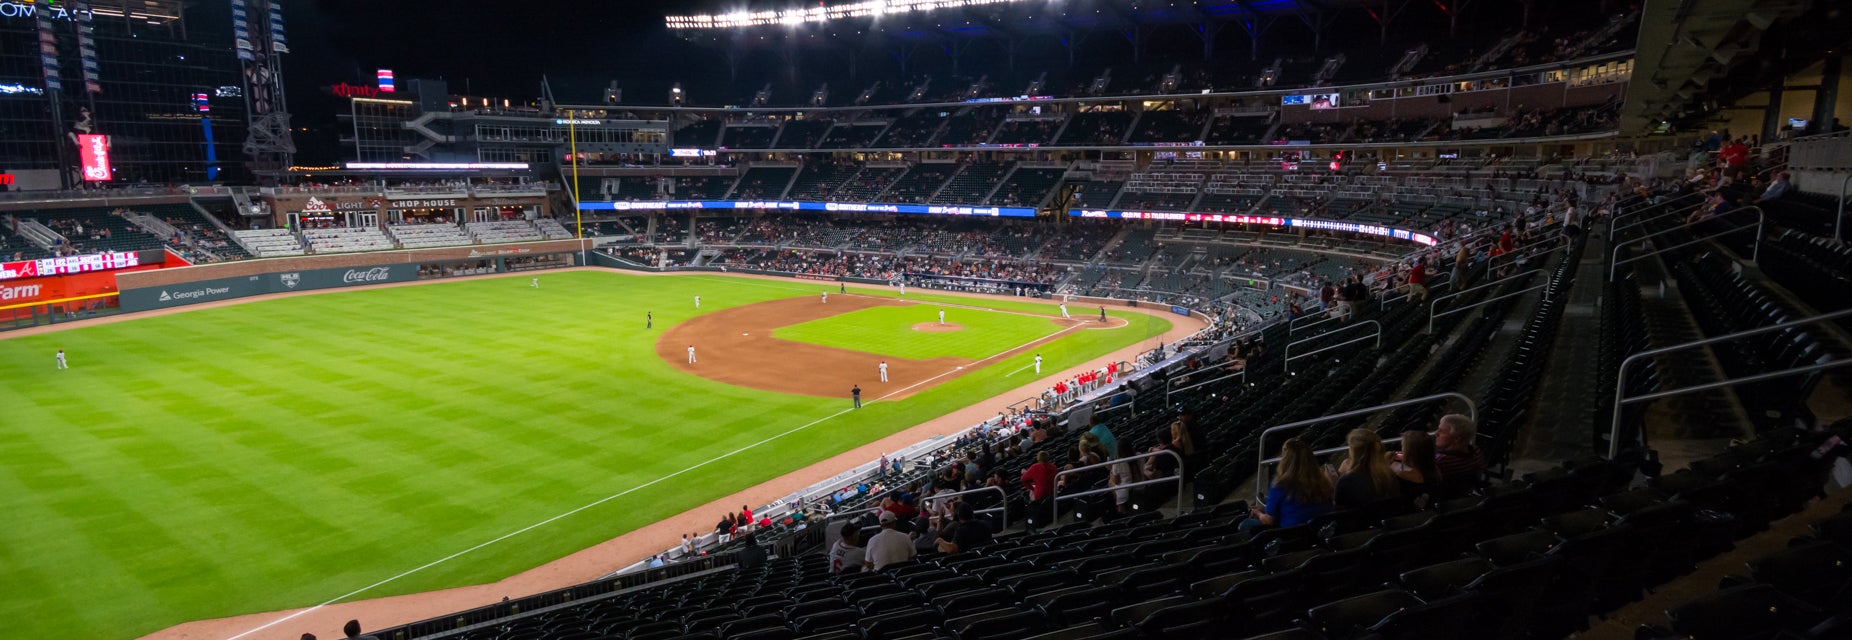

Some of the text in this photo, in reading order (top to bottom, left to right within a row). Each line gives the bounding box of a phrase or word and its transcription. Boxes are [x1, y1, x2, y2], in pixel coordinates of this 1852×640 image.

[392, 199, 456, 208] CHOP HOUSE
[343, 266, 390, 283] Coca-Cola
[173, 286, 230, 300] Georgia Power
